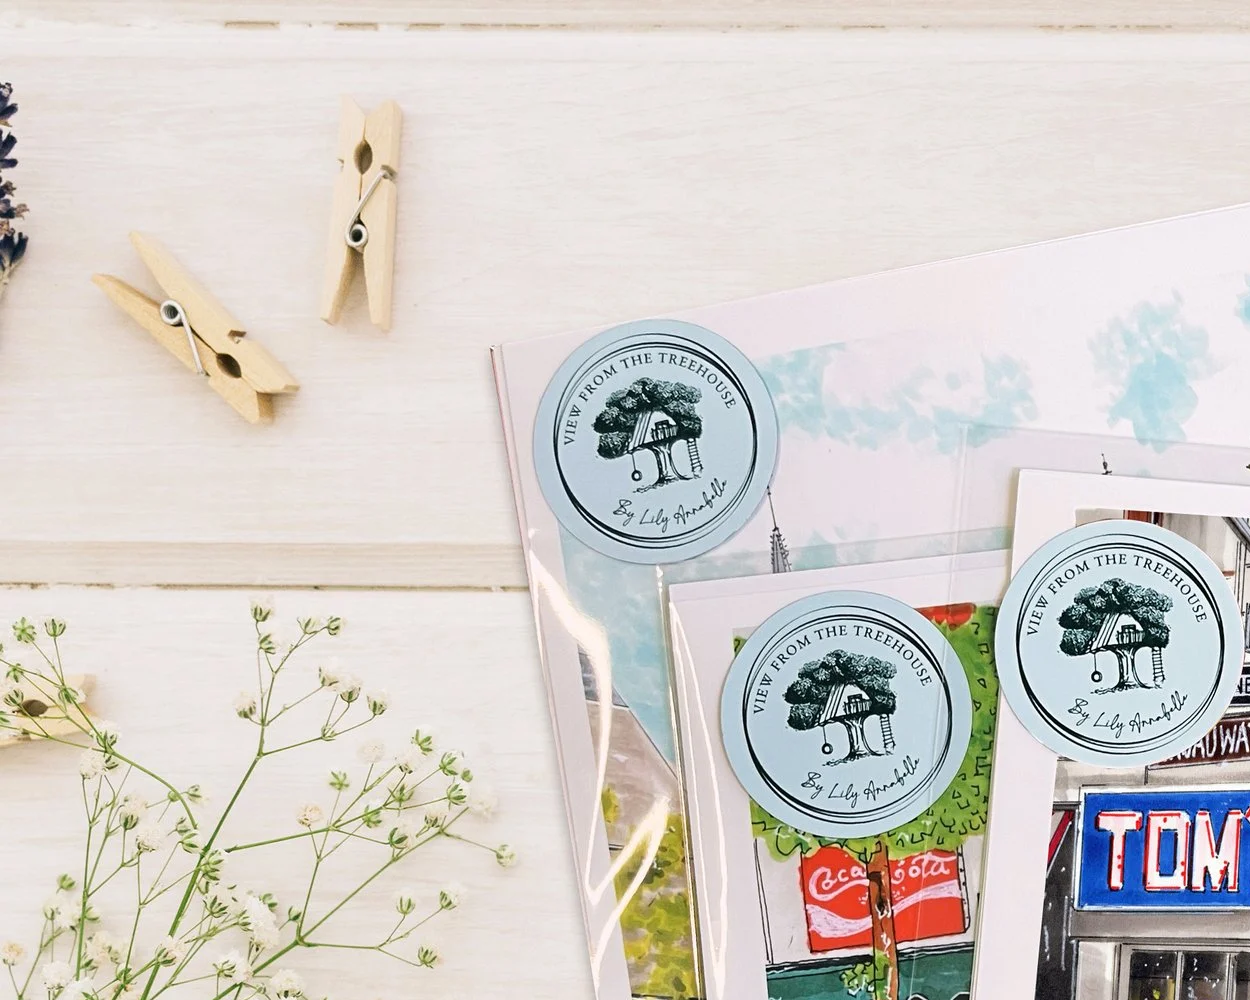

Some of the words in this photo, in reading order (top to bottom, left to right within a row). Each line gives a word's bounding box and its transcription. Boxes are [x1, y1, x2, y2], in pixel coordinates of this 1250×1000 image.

[564, 404, 583, 446] VIEW
[578, 364, 619, 402] FROM
[620, 352, 653, 370] THE
[658, 352, 737, 409] TREEHOUSE
[613, 499, 636, 527] By
[639, 508, 671, 533] Lily
[1027, 594, 1050, 636] VIEW
[1047, 559, 1090, 596] FROM
[1093, 553, 1127, 568] THE
[1133, 554, 1208, 623] TREEHOUSE
[753, 674, 774, 714] VIEW
[770, 635, 812, 673] FROM
[814, 624, 848, 640] THE
[853, 625, 933, 687] TREEHOUSE
[1067, 698, 1090, 726] By
[1093, 712, 1126, 739] Lily
[801, 771, 825, 799] By
[828, 783, 860, 808] Lily
